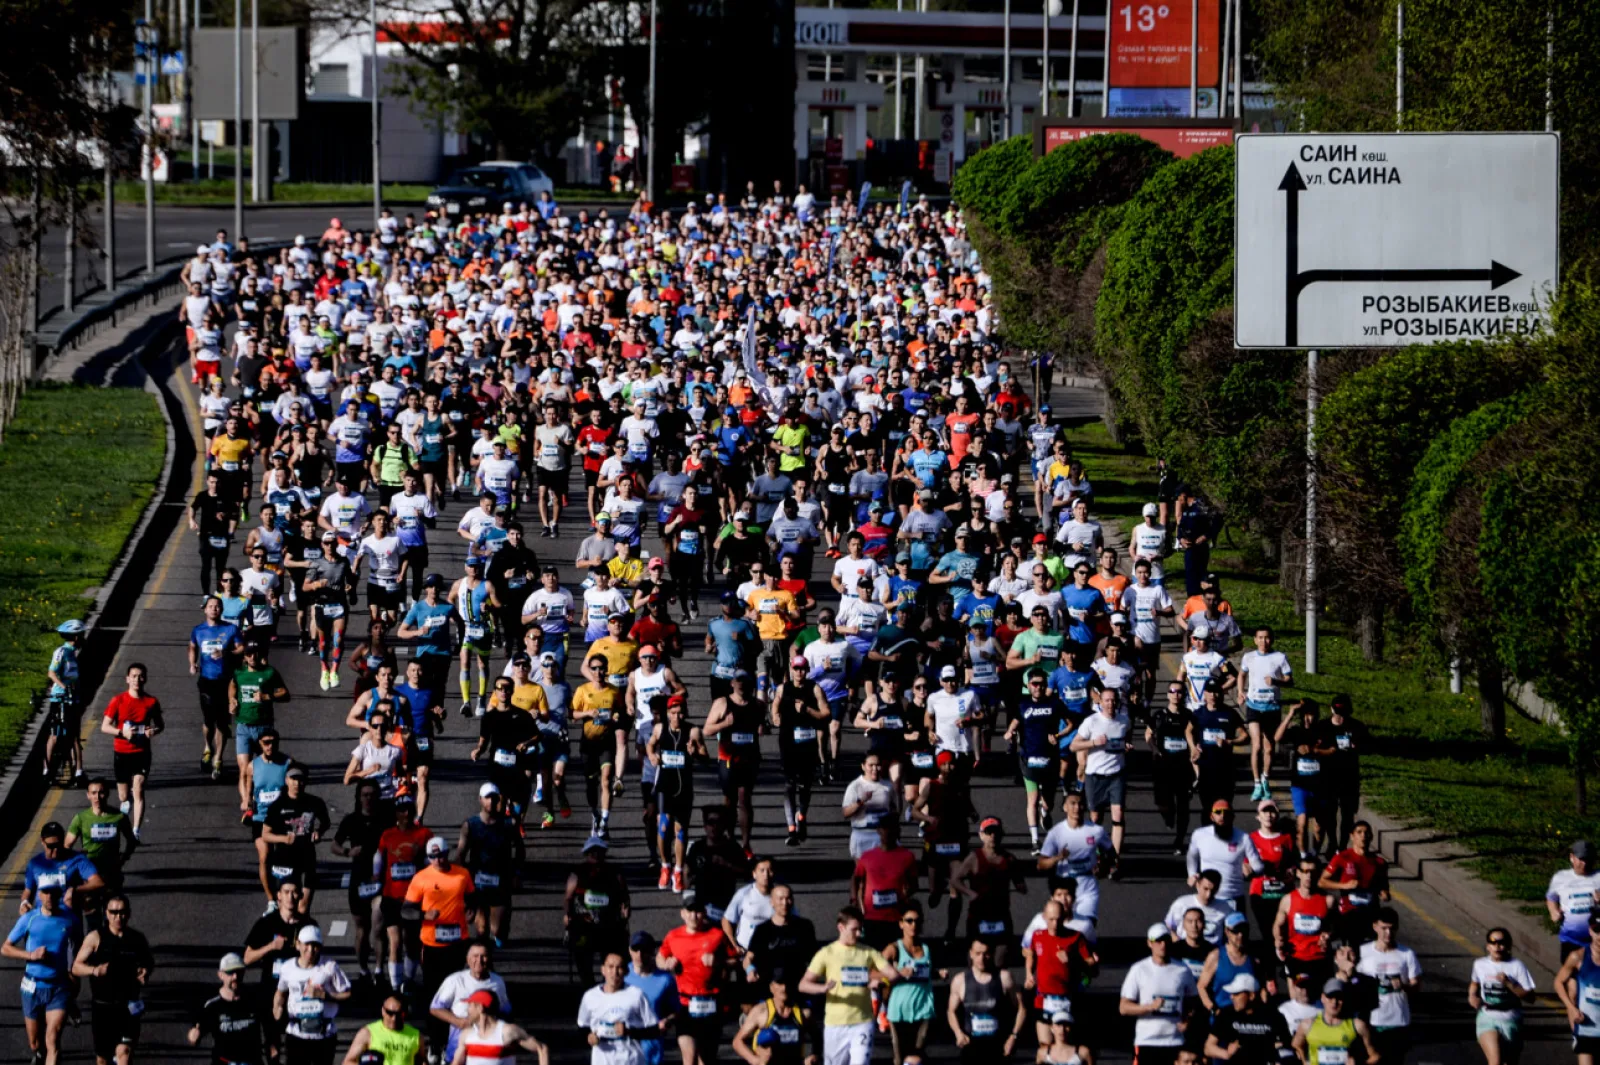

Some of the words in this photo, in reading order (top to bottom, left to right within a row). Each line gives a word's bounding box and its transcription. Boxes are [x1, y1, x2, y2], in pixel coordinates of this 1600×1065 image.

[1119, 4, 1170, 32] 13°
[1300, 144, 1357, 162] САИН
[1306, 174, 1325, 185] ул.
[1328, 166, 1401, 185] САИНА
[1362, 295, 1511, 313] РОЗЫБАКИЕВ
[1232, 1020, 1271, 1031] GARMIN
